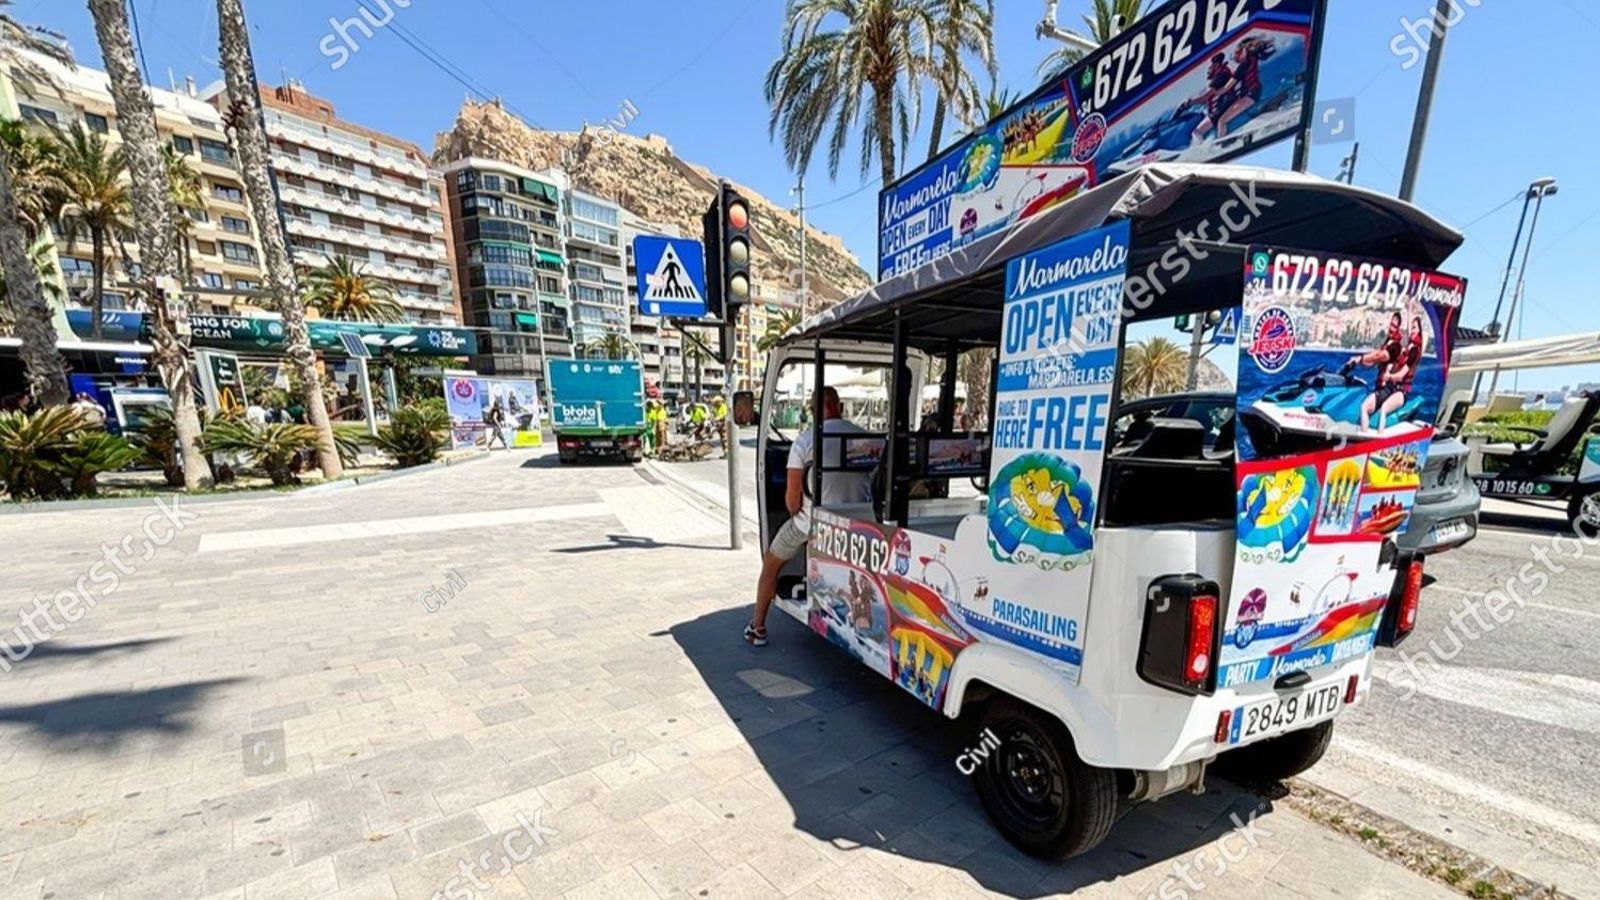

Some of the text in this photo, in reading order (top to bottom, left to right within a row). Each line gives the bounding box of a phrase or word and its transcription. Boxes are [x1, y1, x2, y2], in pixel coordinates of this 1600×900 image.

[1094, 32, 1146, 109] 672
[1153, 0, 1196, 75] 62
[881, 220, 907, 258] OPEN
[929, 197, 952, 234] DAY
[1009, 235, 1129, 299] Marmarela
[1272, 253, 1320, 299] 672
[1322, 258, 1353, 303] 62
[1355, 262, 1384, 305] 62
[1385, 266, 1411, 309] 62
[222, 319, 251, 330] FOR
[1006, 291, 1076, 354] OPEN
[994, 418, 1028, 449] HERE
[1026, 393, 1110, 451] FREE
[1518, 481, 1535, 495] 60
[834, 527, 848, 563] 62
[850, 532, 868, 568] 62
[870, 537, 890, 576] 62
[992, 598, 1078, 643] PARASAILING
[1223, 659, 1262, 688] PARTY
[1245, 685, 1341, 737] 2849 MTB
